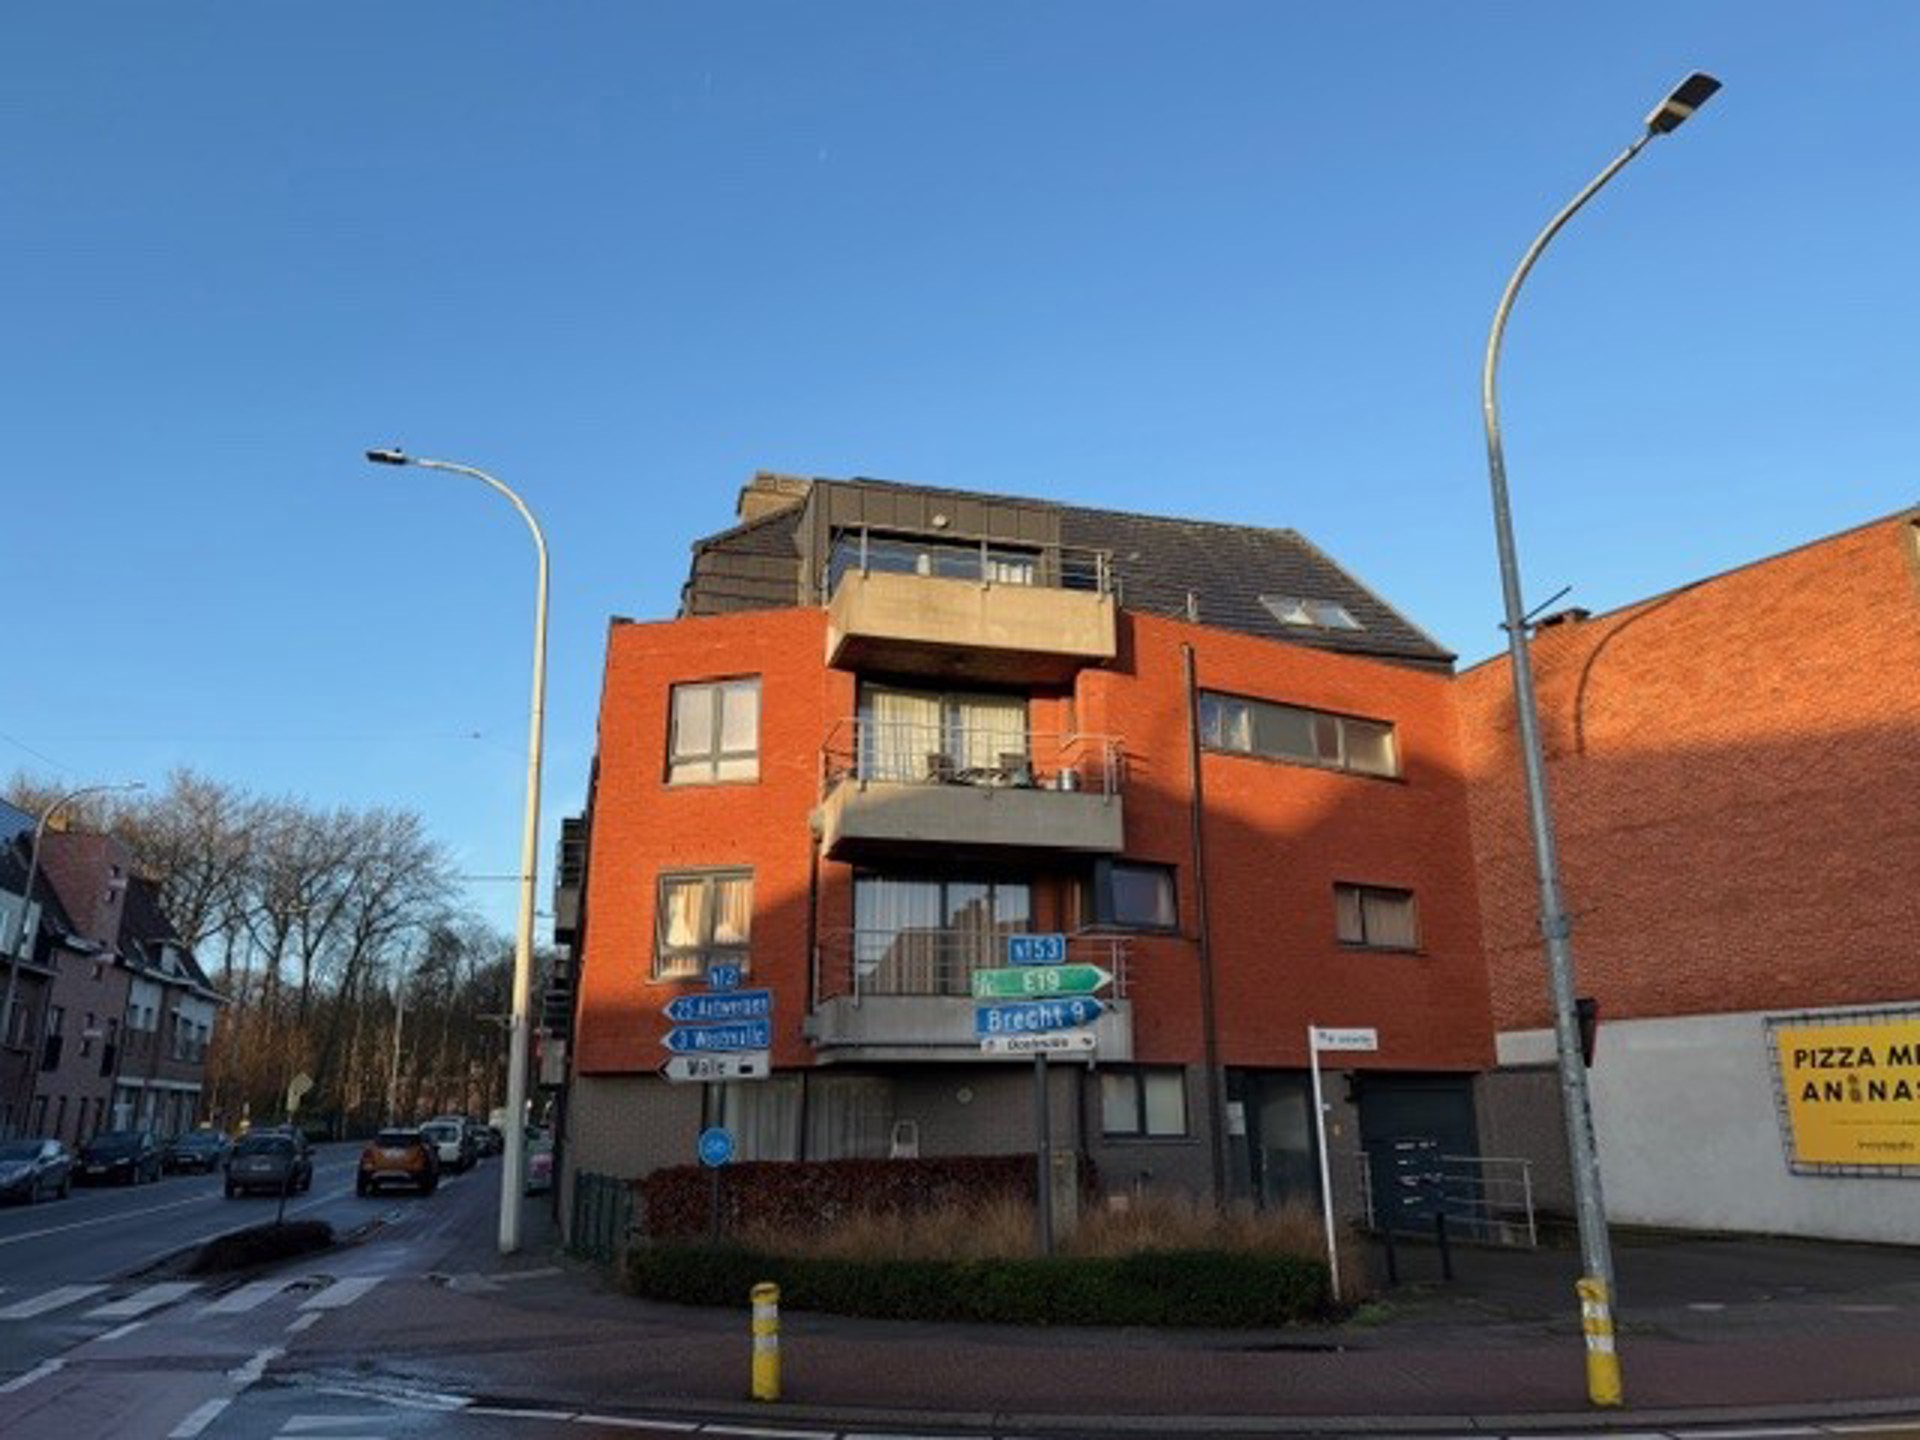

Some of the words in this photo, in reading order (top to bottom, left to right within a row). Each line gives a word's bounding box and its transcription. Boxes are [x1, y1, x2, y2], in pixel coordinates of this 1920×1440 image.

[1022, 970, 1060, 993] E19
[987, 1005, 1064, 1032] Brecht
[1794, 1046, 1876, 1069] PIZZA
